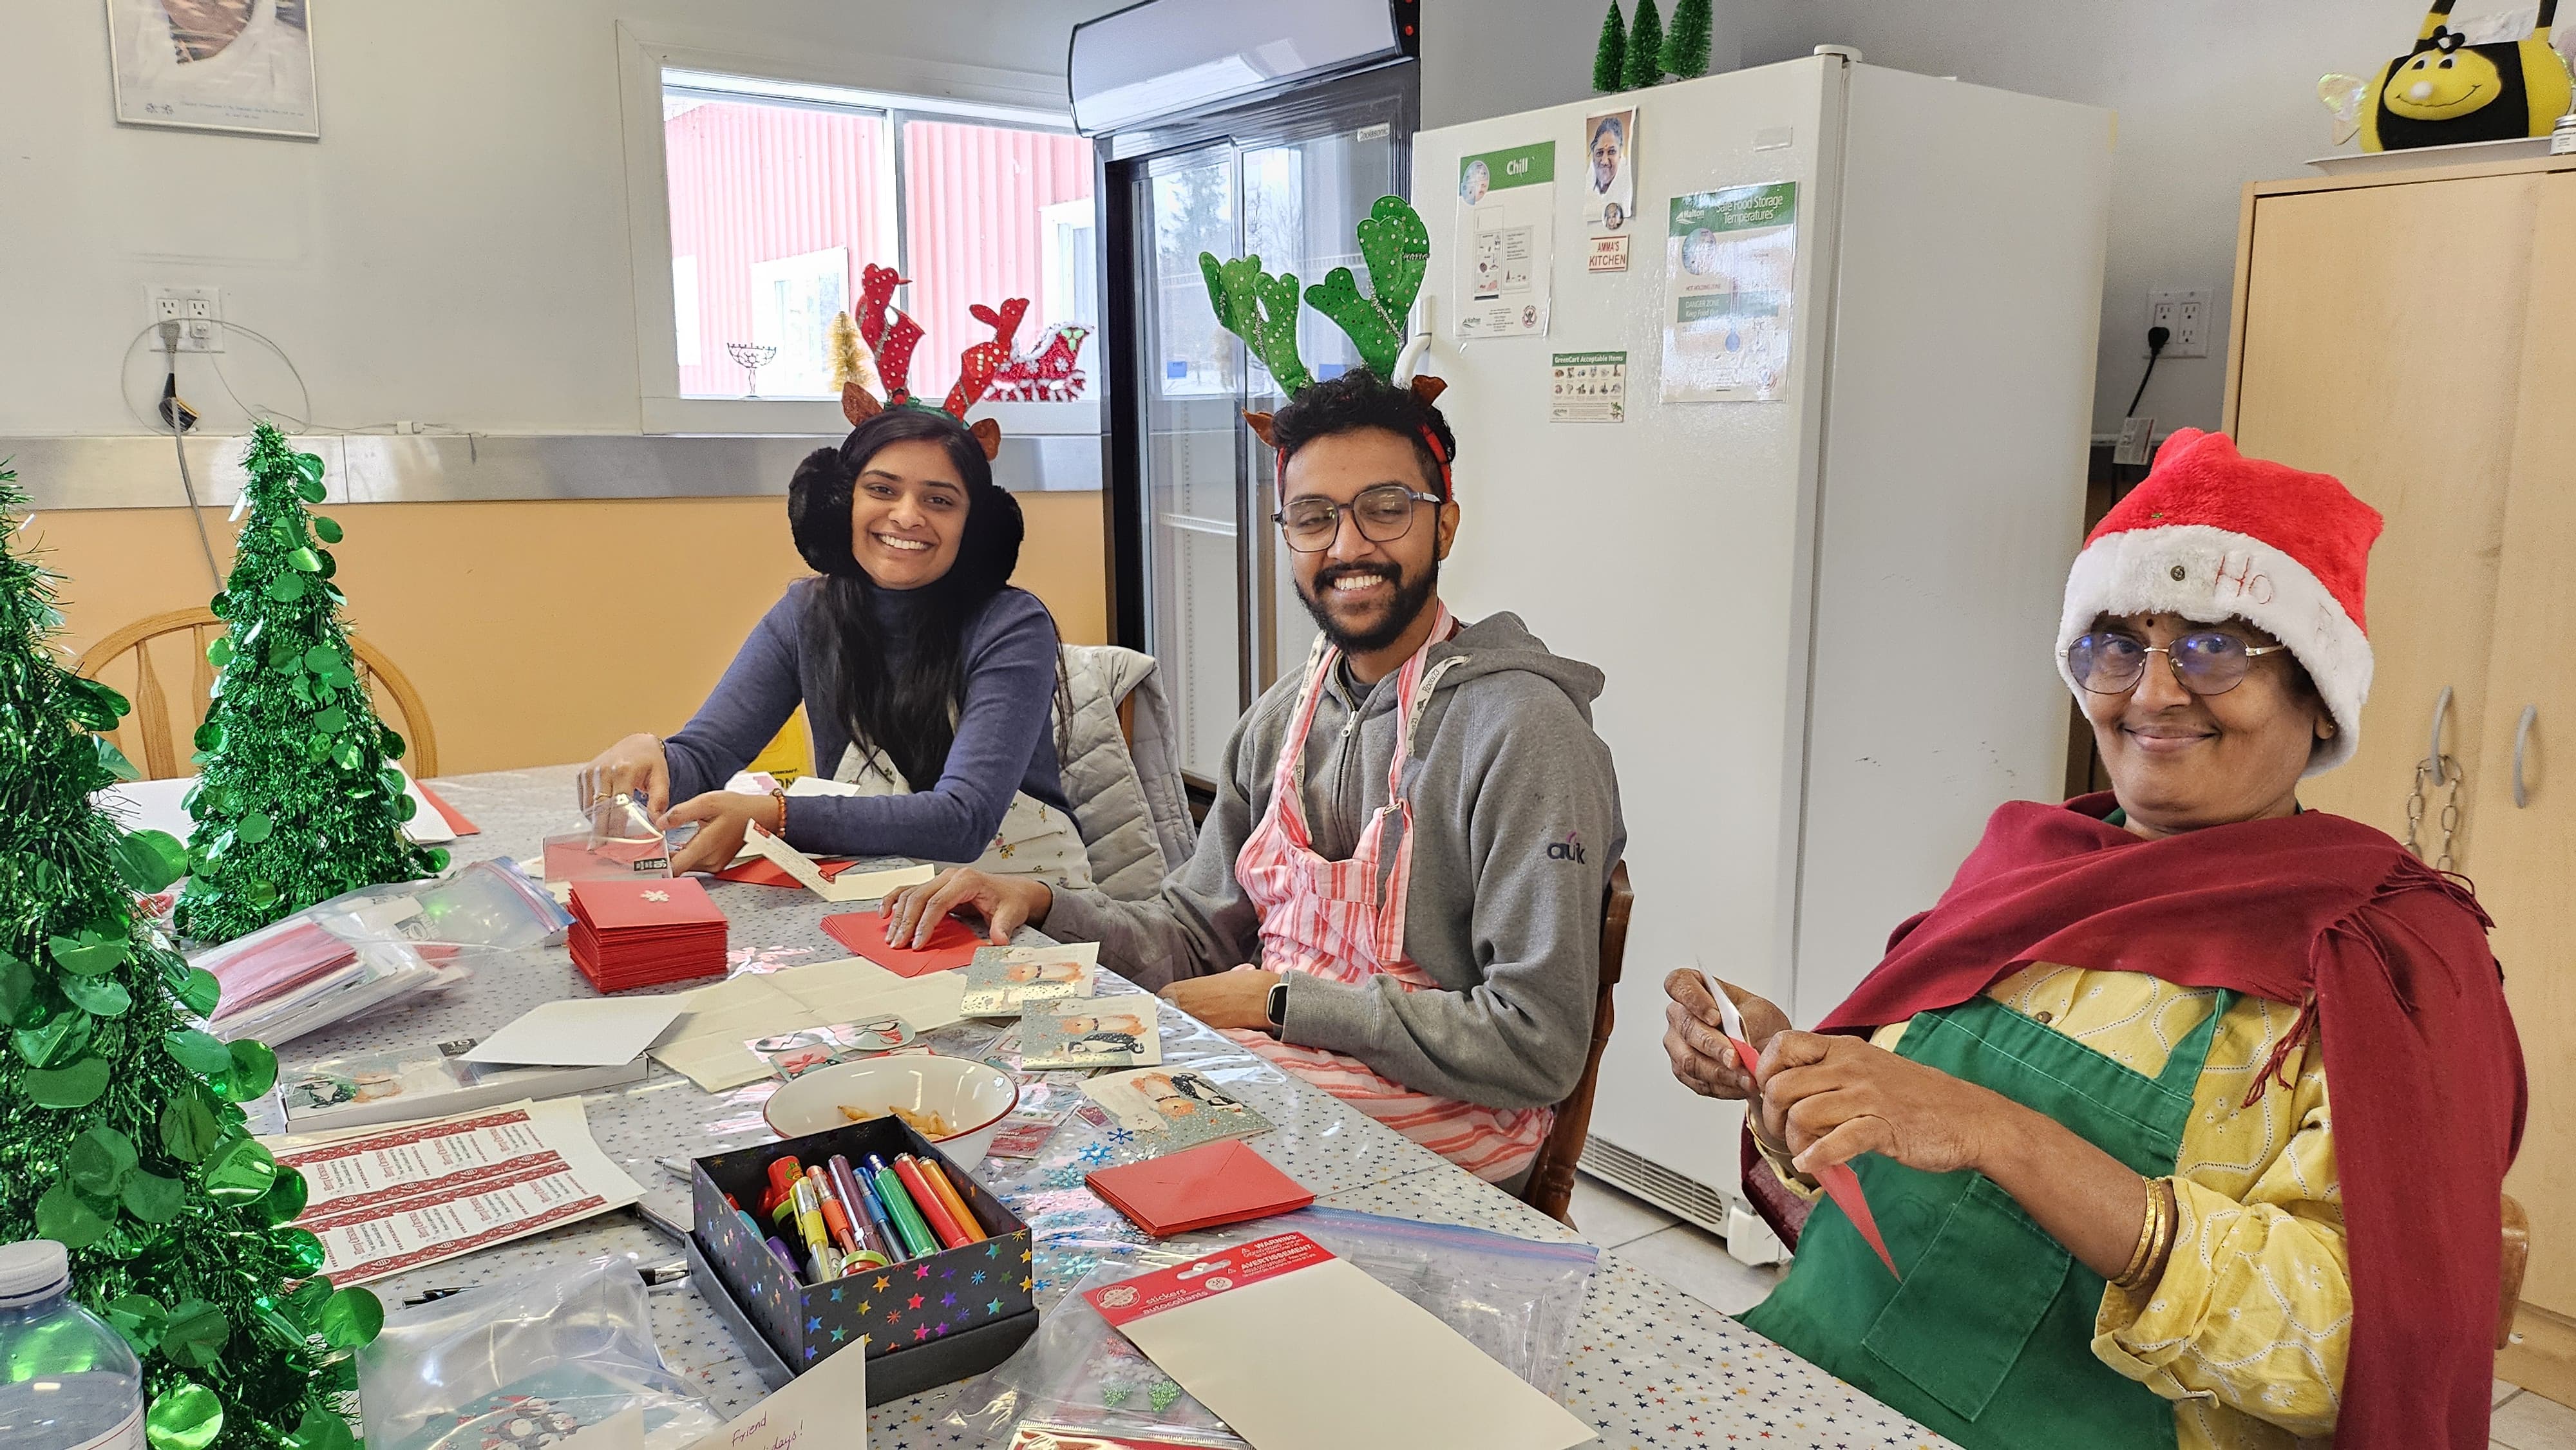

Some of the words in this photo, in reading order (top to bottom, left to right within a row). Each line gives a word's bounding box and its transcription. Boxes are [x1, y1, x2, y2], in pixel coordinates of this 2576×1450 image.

[1507, 157, 1528, 175] Chill
[1716, 202, 1732, 212] Safe
[1734, 198, 1752, 210] Food
[1754, 195, 1783, 209] Storage
[1723, 209, 1774, 224] Temperatures
[1597, 241, 1619, 252] AMMA'S
[1589, 254, 1625, 267] KITCHEN
[1685, 300, 1707, 308] DANGER
[1685, 310, 1697, 318] Keep
[1580, 355, 1608, 364] Acceptable
[2214, 554, 2274, 605] HO
[1422, 669, 1440, 693] Roots73
[1208, 1277, 1226, 1286] 36
[1142, 1290, 1208, 1315] autocollants
[1146, 1288, 1187, 1305] stickers
[732, 1411, 767, 1447] Friend
[762, 1419, 803, 1450] days!
